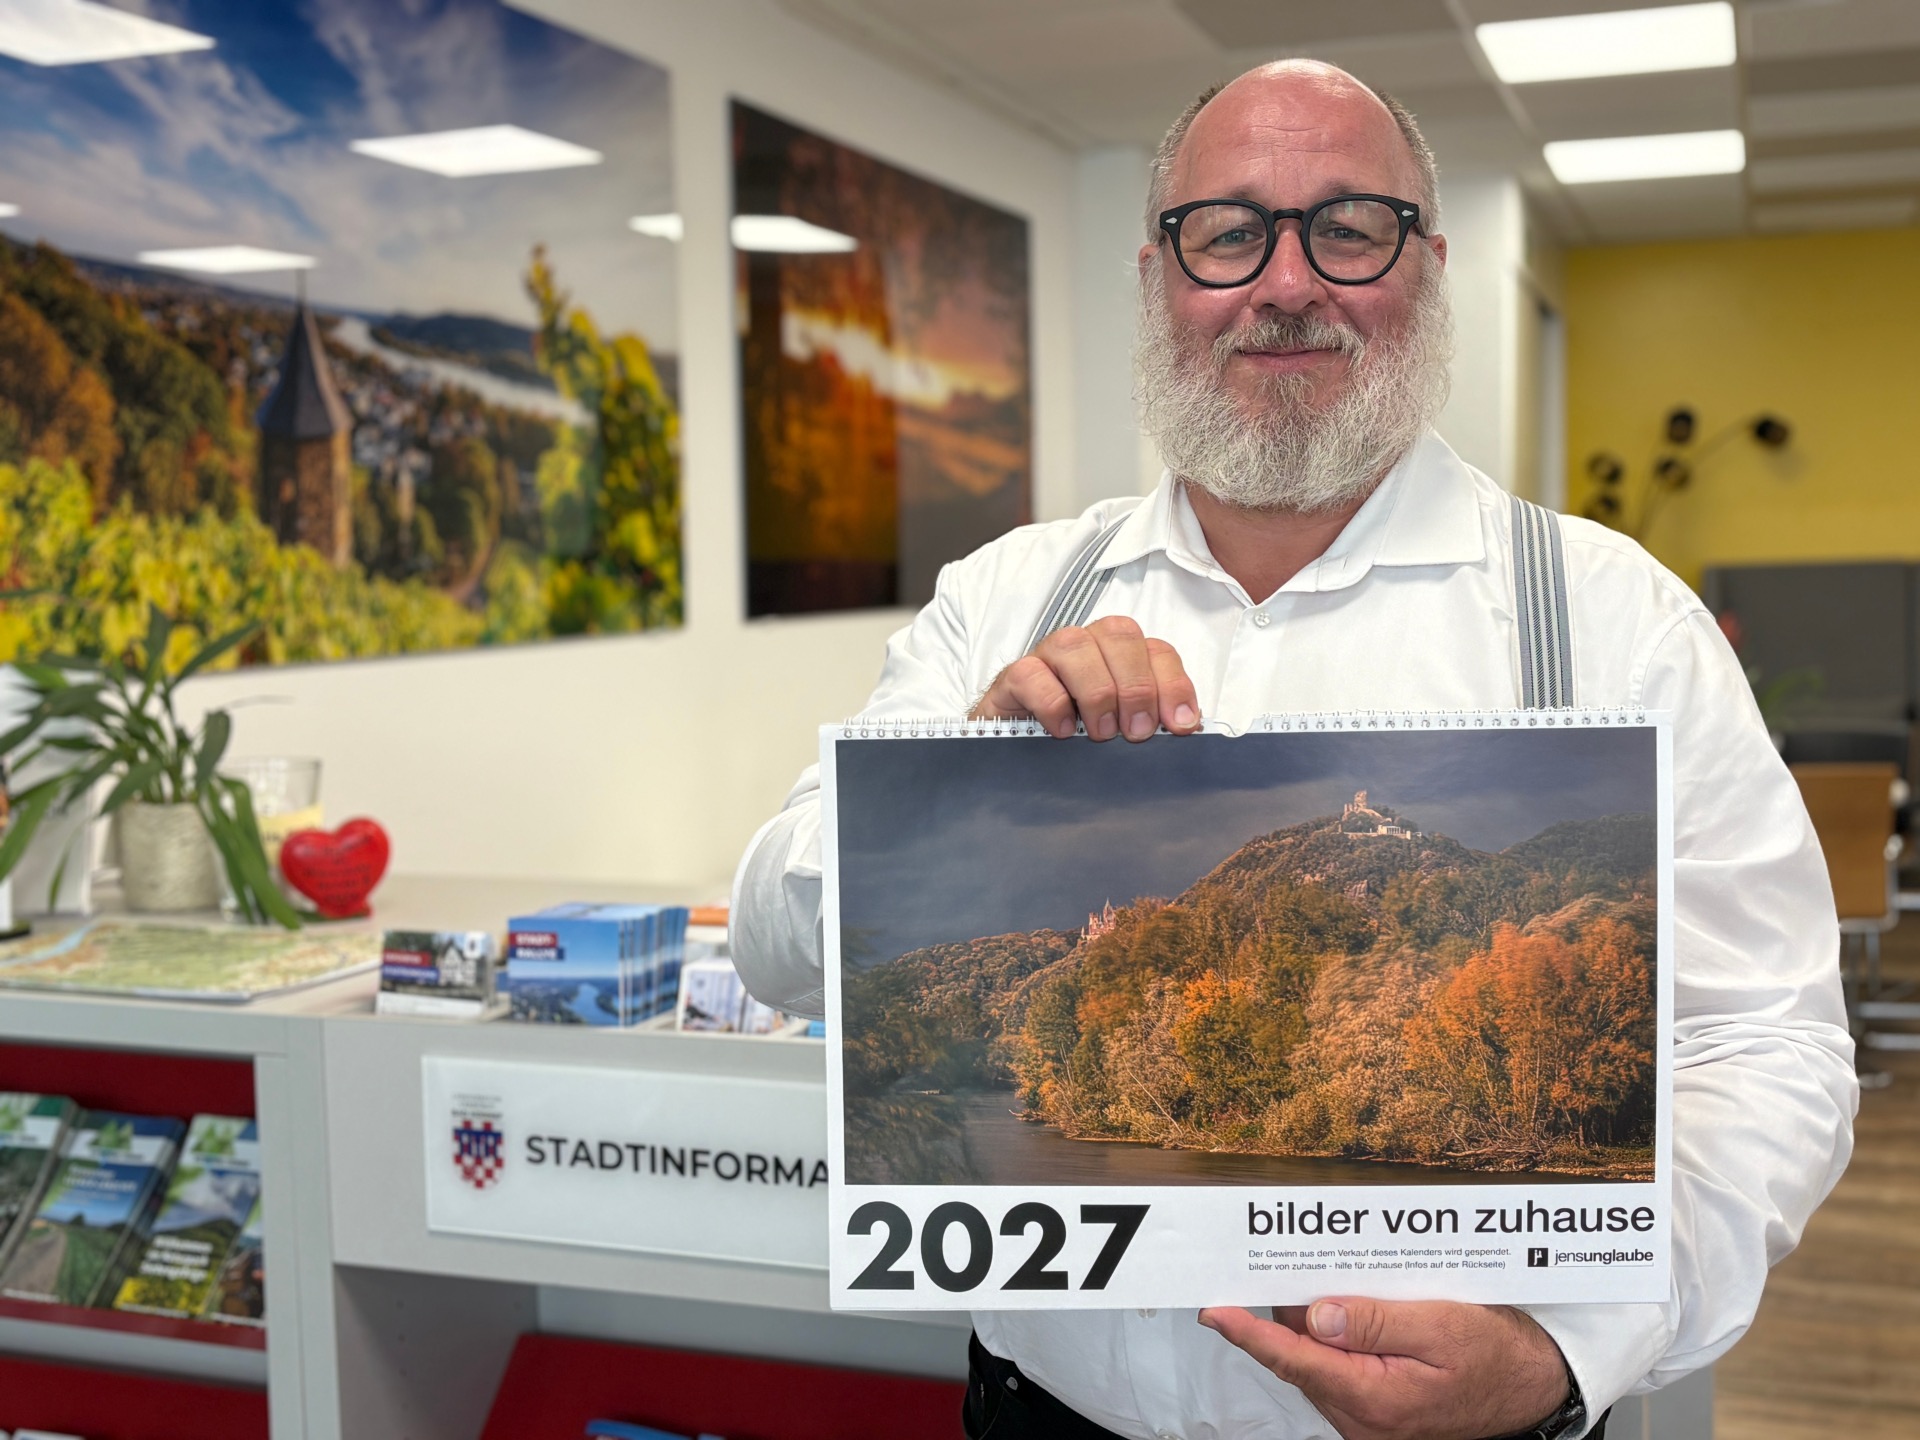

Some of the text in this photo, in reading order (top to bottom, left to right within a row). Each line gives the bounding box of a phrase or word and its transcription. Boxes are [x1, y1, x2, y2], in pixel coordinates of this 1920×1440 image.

[526, 1136, 829, 1188] STADTINFORMA
[1248, 1199, 1655, 1236] bilder von zuhause
[846, 1201, 1151, 1293] 2027
[1248, 1247, 1512, 1258] Der Gewinn aus dem Verkauf dieses Kalenders wird gespendet.
[1554, 1248, 1654, 1265] jensunglaube
[1248, 1262, 1273, 1271] bilder
[1274, 1263, 1290, 1271] von
[1291, 1262, 1327, 1271] zuhause
[1334, 1261, 1353, 1270] hilfe
[1354, 1261, 1366, 1270] für
[1367, 1261, 1403, 1270] zuhause
[1404, 1260, 1429, 1271] (Infos
[1429, 1260, 1444, 1269] auf
[1445, 1260, 1460, 1269] der
[1461, 1260, 1506, 1270] Rückseite)
